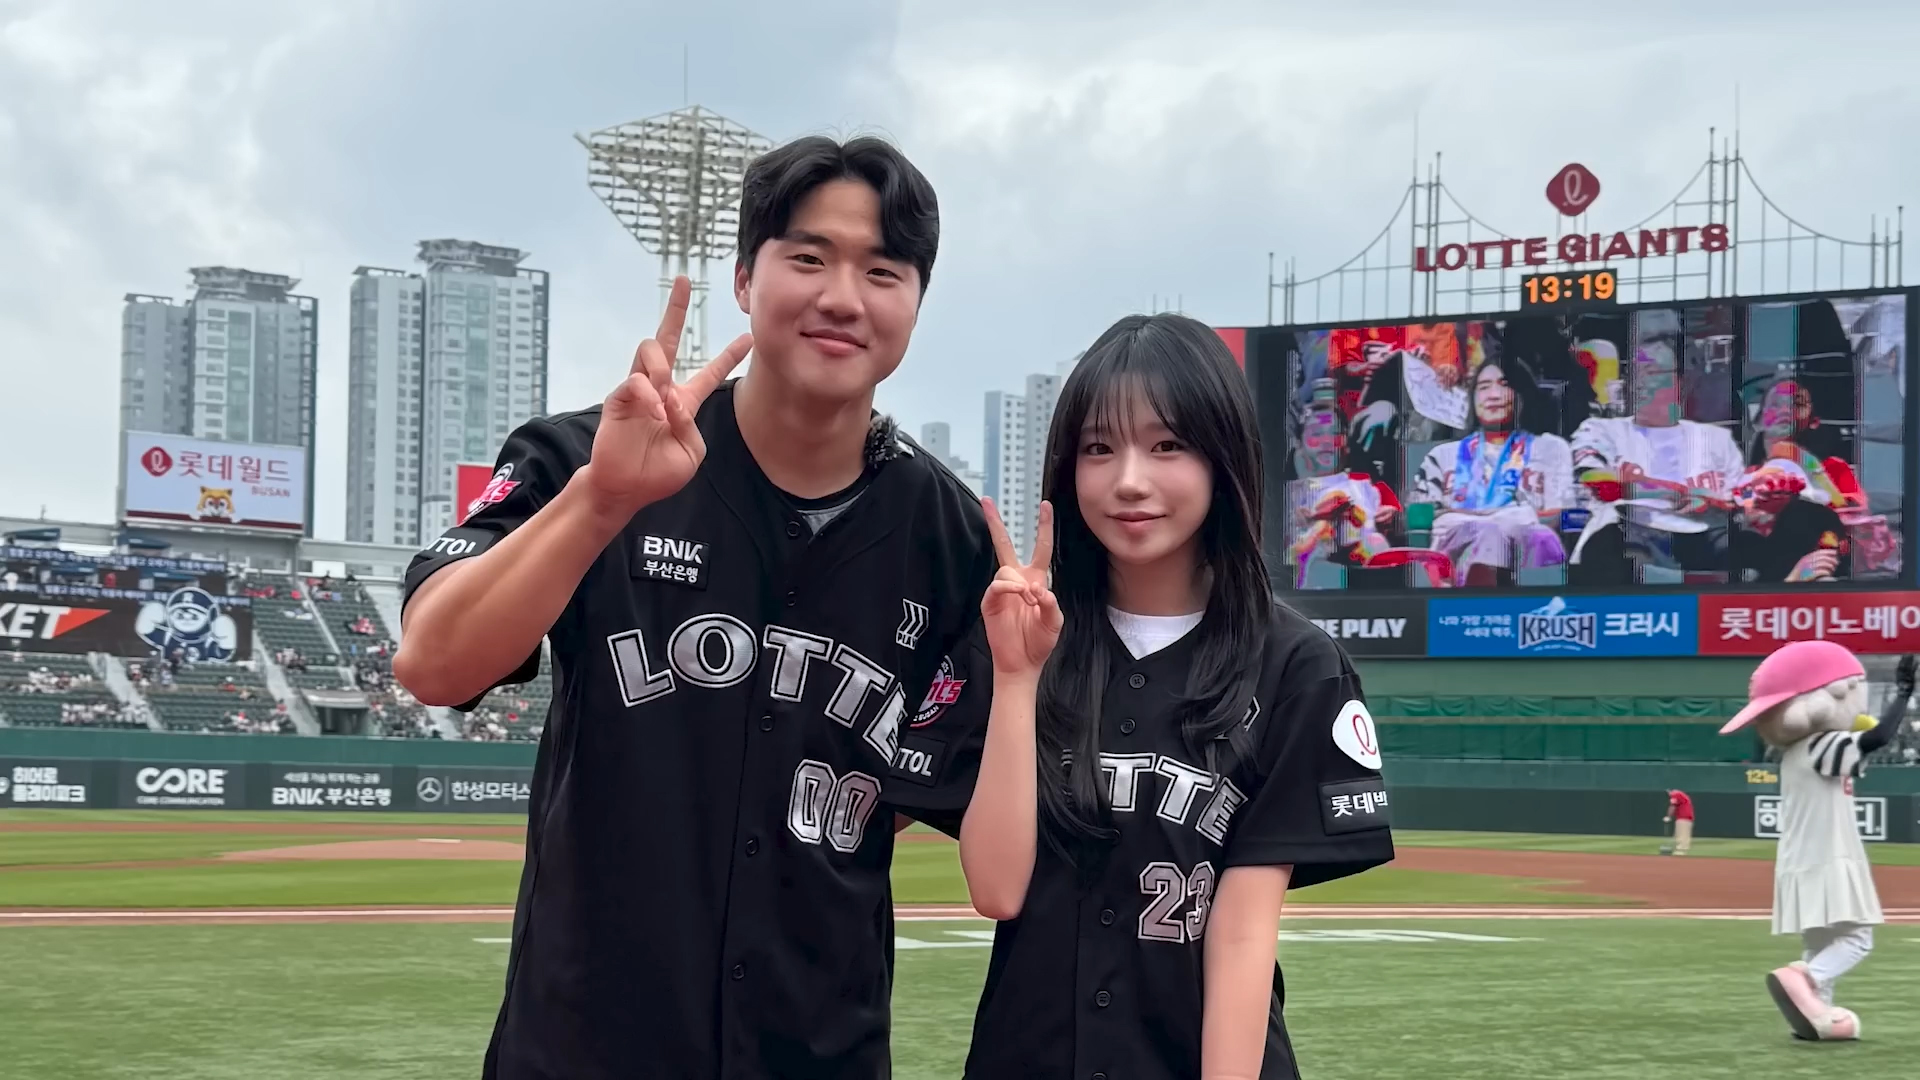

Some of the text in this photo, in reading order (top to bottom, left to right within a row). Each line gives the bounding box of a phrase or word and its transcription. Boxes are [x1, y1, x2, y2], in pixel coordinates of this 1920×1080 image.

[1416, 224, 1729, 272] LOTTE GIANTS
[1525, 272, 1615, 303] 13:19
[178, 450, 291, 484] 롯데월드
[251, 484, 290, 498] BUSAN
[643, 535, 704, 564] BNK
[643, 559, 699, 583] 부산은행
[1341, 618, 1407, 638] PLAY
[1519, 613, 1597, 649] KRUSH
[1603, 612, 1679, 637] 크러시
[607, 613, 908, 767] LOTTE
[136, 767, 229, 794] CORE
[451, 781, 531, 801] 한성모터스
[271, 787, 393, 806] BNK 부산은행
[787, 759, 882, 854] 00
[1100, 752, 1249, 847] TTE
[1138, 861, 1215, 944] 23
